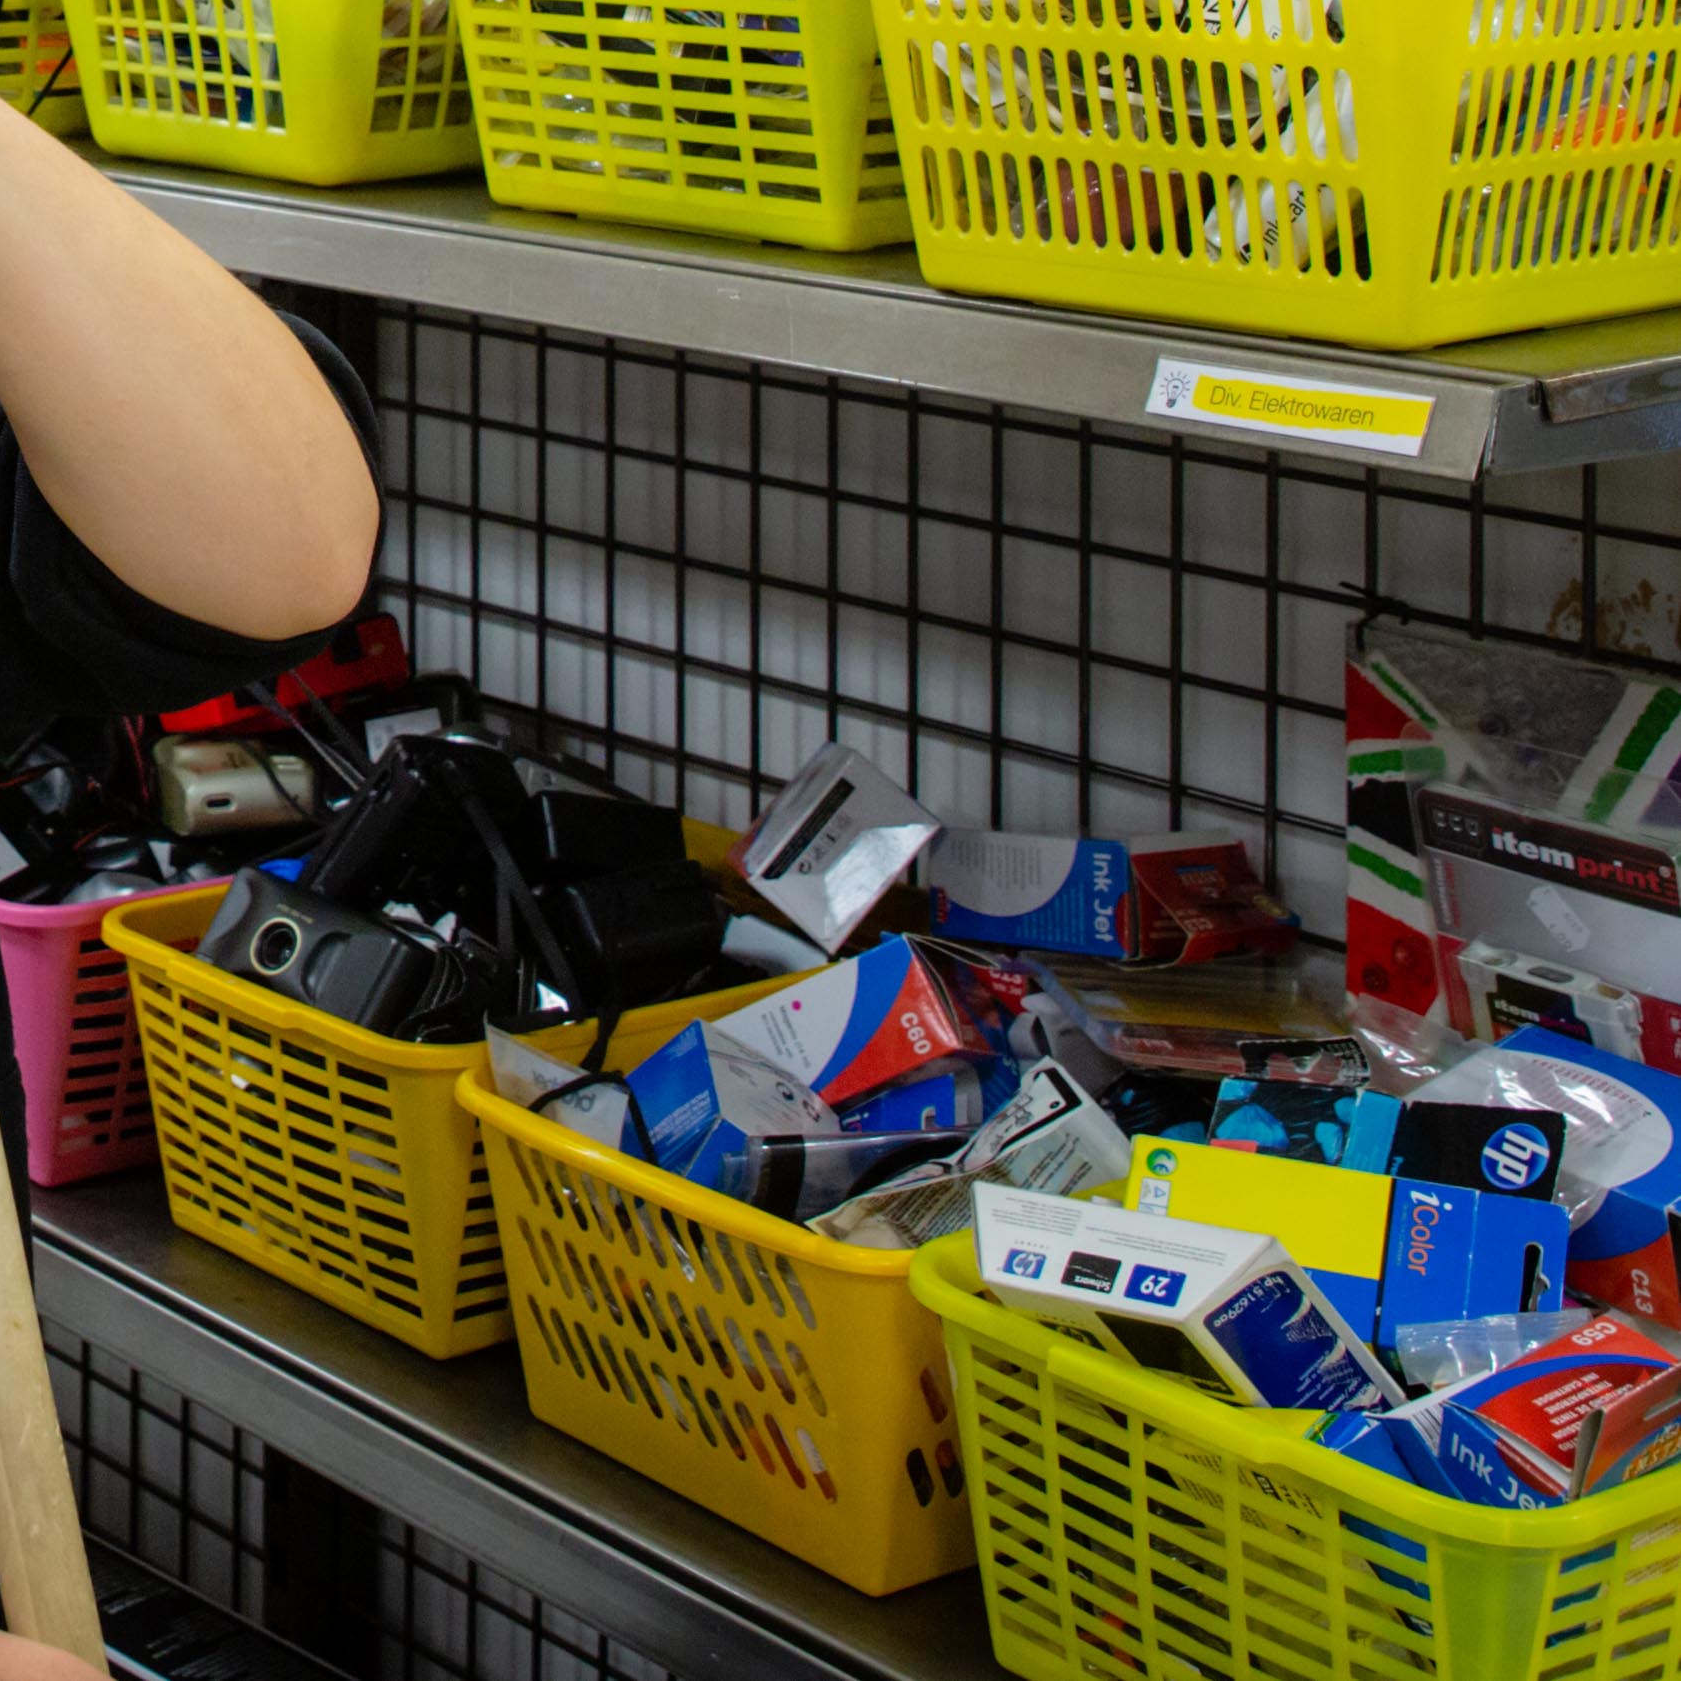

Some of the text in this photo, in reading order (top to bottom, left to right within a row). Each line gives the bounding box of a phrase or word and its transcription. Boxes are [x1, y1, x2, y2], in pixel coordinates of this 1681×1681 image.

[1208, 385, 1376, 427] Div. Elektrowaren
[1092, 852, 1113, 943] Ink Jet
[900, 1011, 932, 1055] C60
[1485, 1129, 1551, 1186] hp
[1409, 1189, 1454, 1278] iColor
[1140, 1272, 1170, 1297] 29
[1570, 1321, 1618, 1347] C59
[1449, 1432, 1495, 1486] Ink
